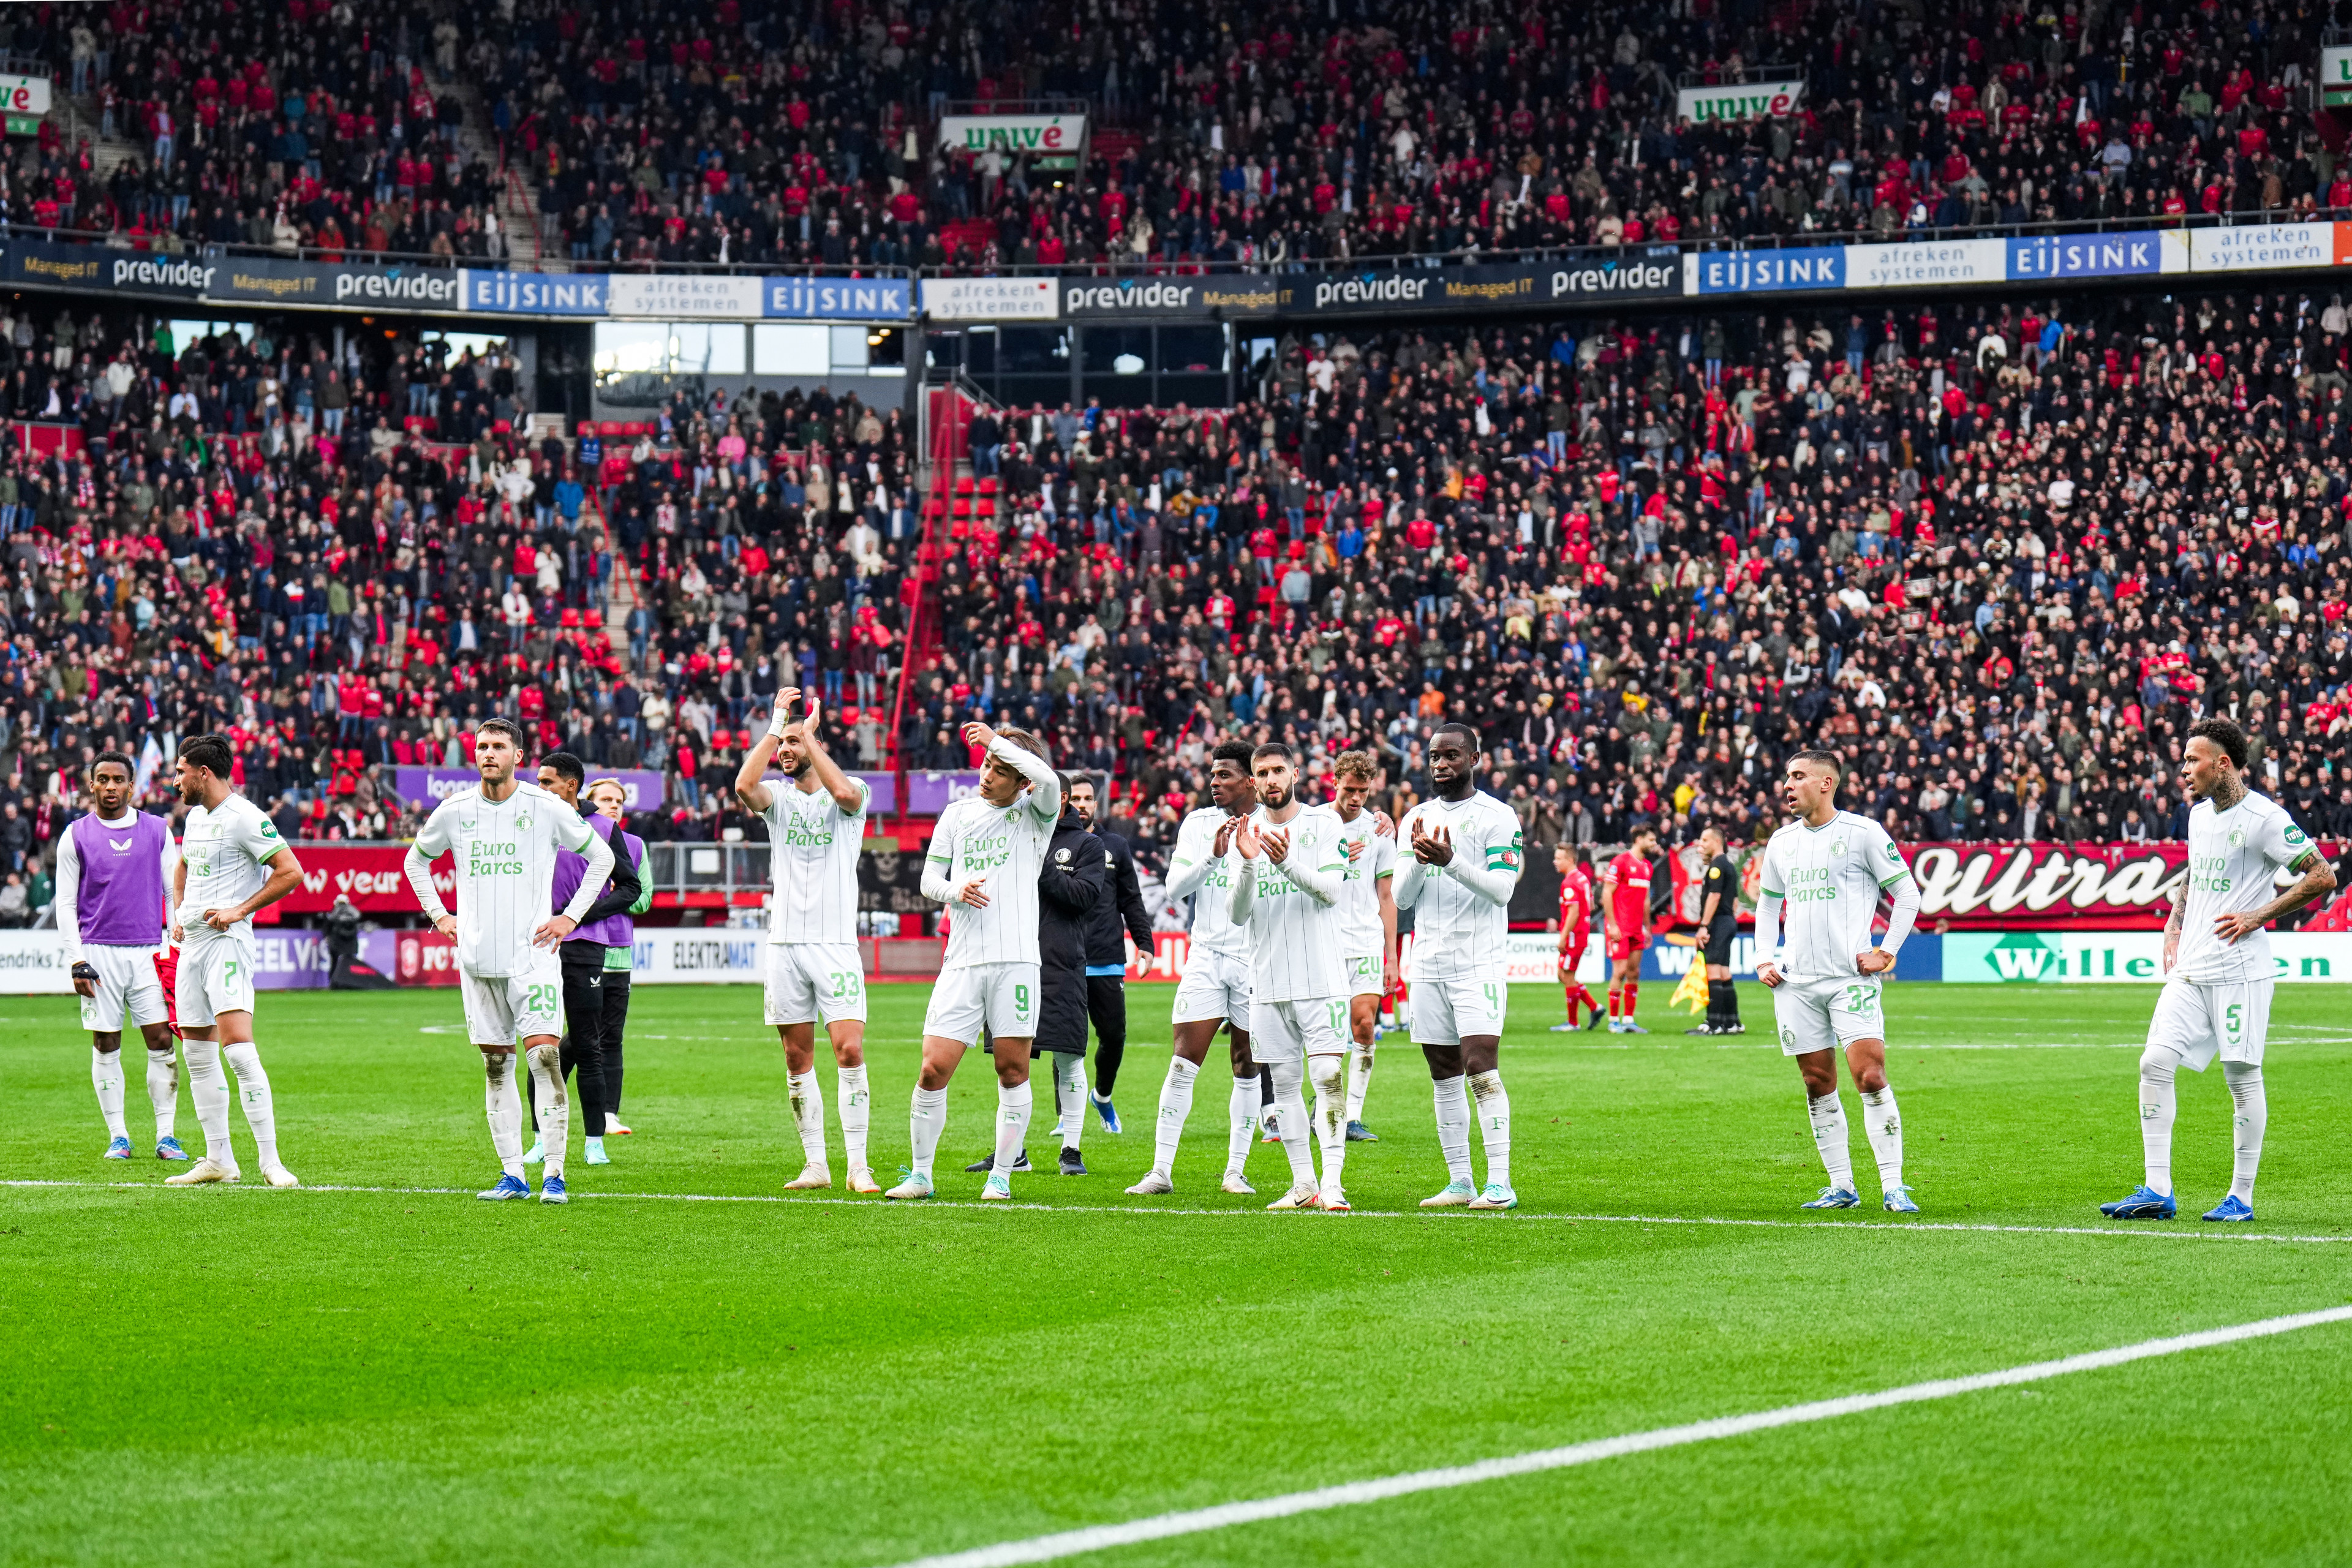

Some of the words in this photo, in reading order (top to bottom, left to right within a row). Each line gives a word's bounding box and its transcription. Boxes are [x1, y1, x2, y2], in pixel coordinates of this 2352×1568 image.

[1694, 85, 1790, 121] univé
[2221, 228, 2310, 246] afreken
[1880, 247, 1964, 265] afreken
[2210, 246, 2321, 268] systemen
[24, 257, 86, 278] Managed
[87, 262, 99, 277] IT
[114, 257, 216, 288] previder
[1869, 263, 1975, 284] systemen
[233, 274, 302, 294] Managed
[303, 277, 317, 292] IT
[336, 270, 456, 301] previder
[644, 276, 729, 295] afreken
[951, 281, 1035, 298] afreken
[1316, 273, 1429, 307] previder
[1446, 281, 1516, 299] Managed
[1519, 279, 1533, 295] IT
[1551, 264, 1675, 299] previder
[635, 295, 739, 312] systemen
[942, 298, 1046, 314] systemen
[1067, 281, 1193, 312] previder
[1203, 290, 1276, 309] Managed
[1278, 289, 1292, 305] IT
[789, 812, 824, 829] Euro
[785, 829, 832, 846] Parcs
[964, 836, 1007, 854] Euro
[2285, 829, 2305, 842] TOTO
[470, 840, 516, 857] Euro
[470, 859, 522, 876] Parcs
[963, 852, 1009, 872] Parcs
[2193, 853, 2225, 871] Euro
[334, 869, 402, 895] veur
[1790, 867, 1828, 884] Euro
[2191, 873, 2231, 892] Parcs
[1257, 878, 1303, 898] Parc
[1791, 887, 1836, 904] Parcs
[0, 948, 51, 968] endriks
[674, 941, 755, 970] ELEKTRAMAT
[1991, 948, 2332, 980] Willeen
[225, 962, 238, 987] 7
[831, 972, 860, 998] 33
[528, 985, 557, 1011] 29
[1015, 985, 1030, 1012] 9
[1483, 984, 1498, 1010] 4
[1847, 986, 1877, 1012] 32
[1326, 1001, 1347, 1028] 17
[2226, 1004, 2242, 1033] 5
[1490, 1117, 1507, 1130] F
